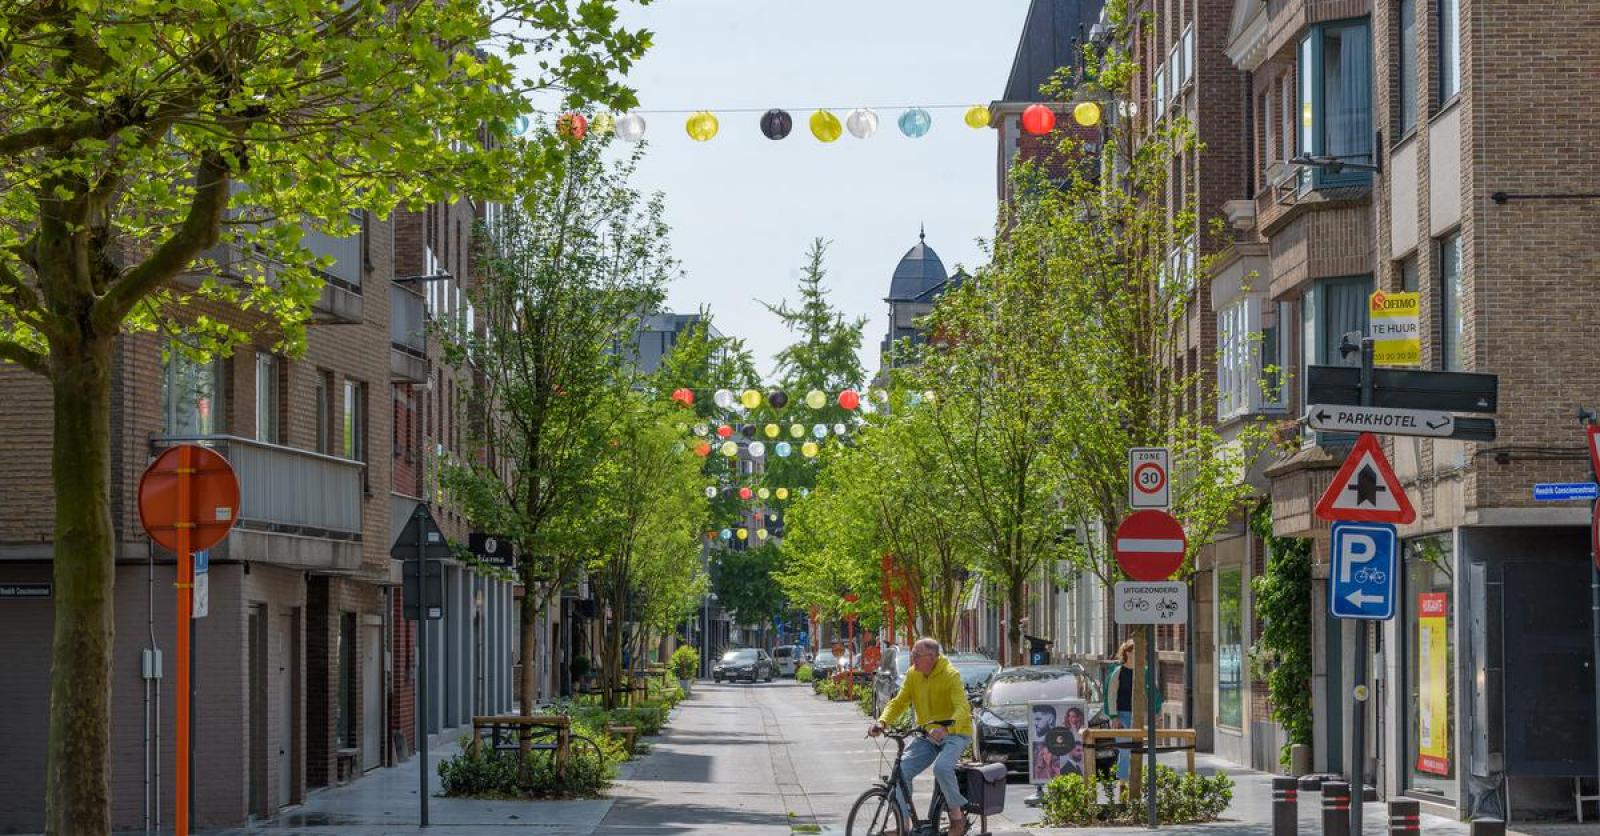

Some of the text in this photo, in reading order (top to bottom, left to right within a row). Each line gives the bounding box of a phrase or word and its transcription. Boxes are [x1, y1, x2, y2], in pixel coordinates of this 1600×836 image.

[1373, 293, 1416, 310] SOFIMO
[1373, 323, 1417, 334] TE HUUR
[1338, 411, 1417, 428] PARKHOTEL
[1141, 472, 1158, 484] 30
[1340, 533, 1376, 583] P
